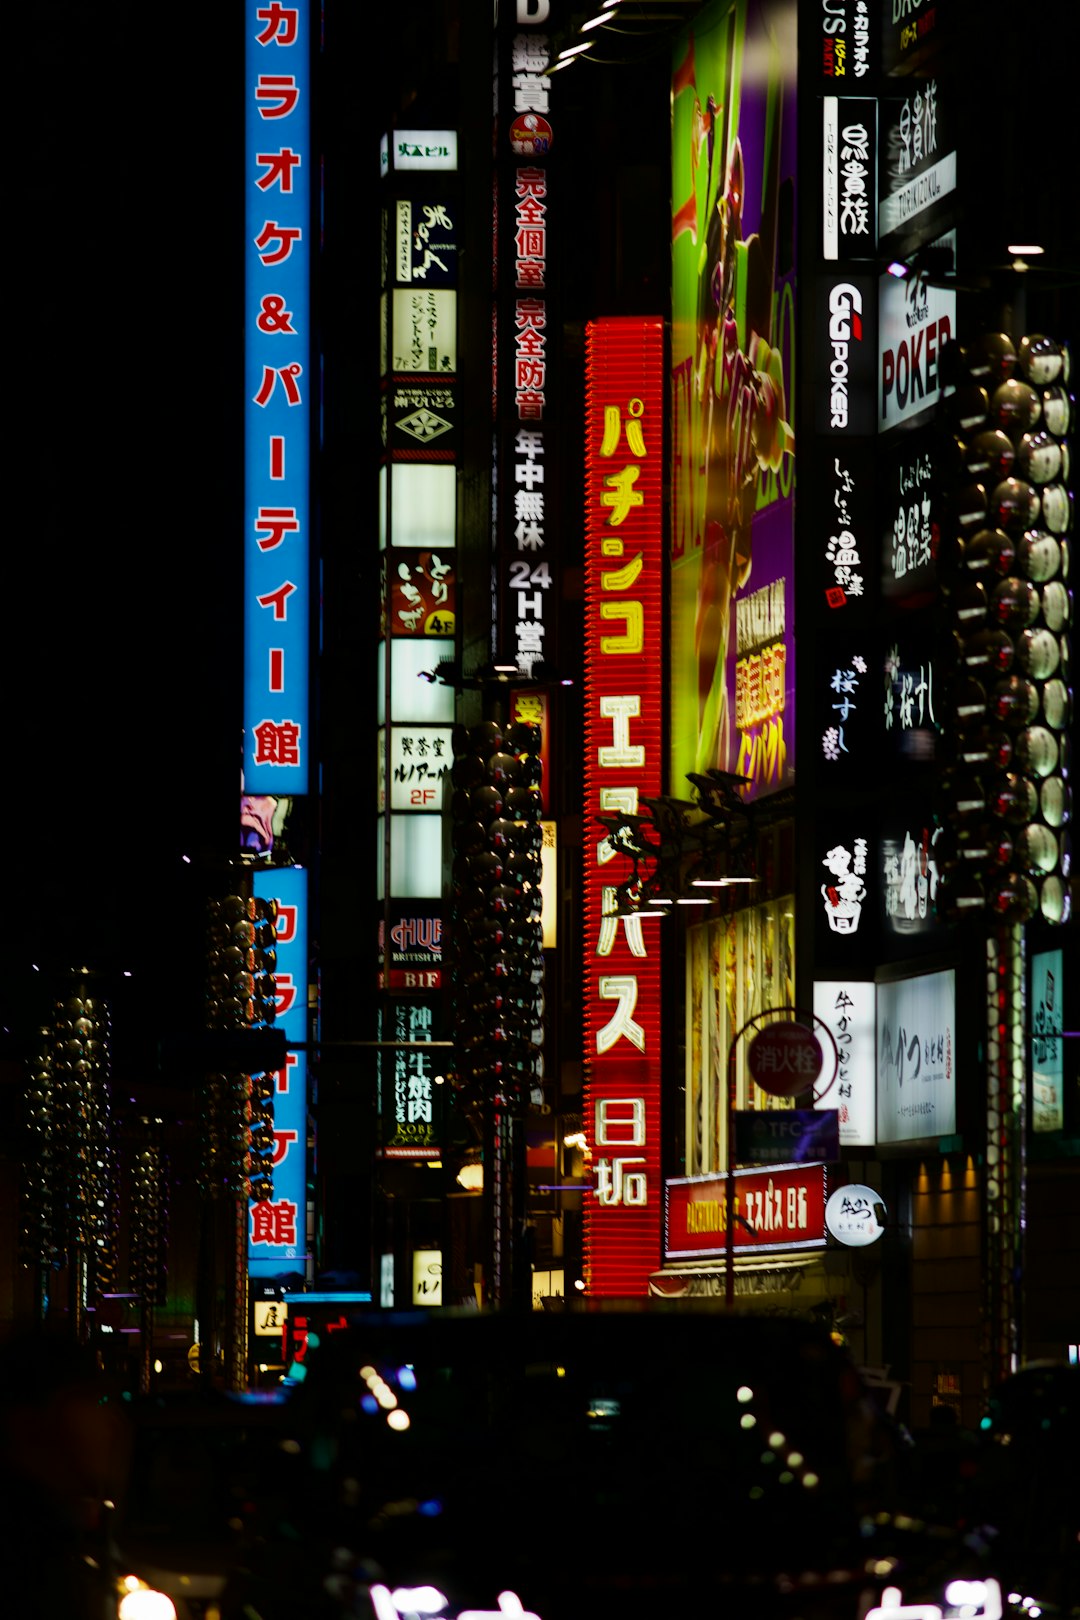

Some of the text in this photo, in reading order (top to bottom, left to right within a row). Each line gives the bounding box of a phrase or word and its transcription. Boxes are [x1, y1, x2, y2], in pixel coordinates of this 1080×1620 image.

[515, 165, 547, 290] 完全個室
[253, 2, 303, 768] カラオケ&パーティー館
[515, 297, 547, 421] 完全防音
[514, 428, 545, 551] 年中無休
[598, 397, 648, 655] パチンコ
[429, 616, 453, 635] 4F
[829, 668, 860, 754] 桜すし
[410, 789, 437, 806] 2F
[392, 952, 431, 963] BRITISH
[404, 971, 439, 988] B1F
[755, 1043, 817, 1074] 消火栓
[593, 1097, 649, 1207] 日拓
